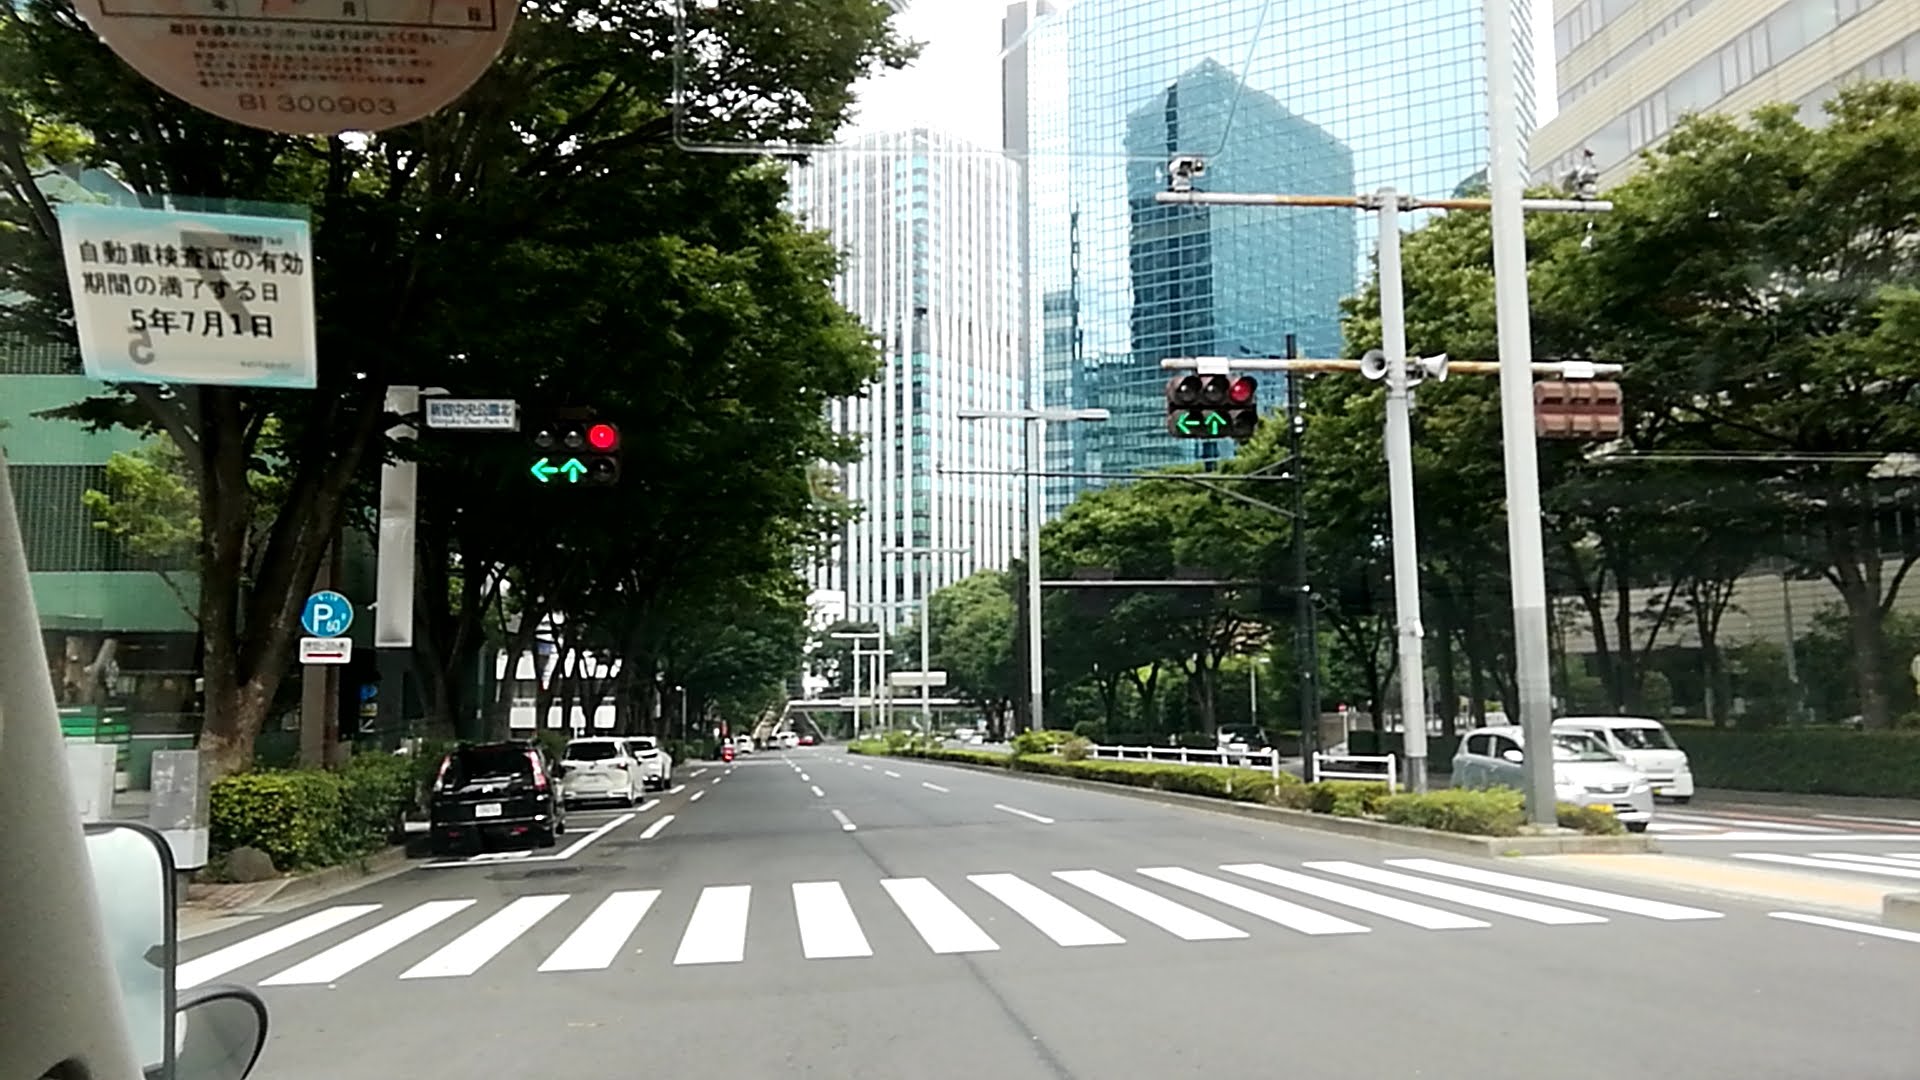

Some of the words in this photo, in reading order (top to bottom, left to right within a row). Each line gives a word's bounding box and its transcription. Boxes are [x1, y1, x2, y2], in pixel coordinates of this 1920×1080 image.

[343, 1, 357, 16] 月
[467, 7, 481, 22] 日
[278, 95, 396, 115] 300903
[79, 240, 304, 276] 自動車検査証の有効
[82, 271, 279, 303] 期間の満了する日
[130, 307, 274, 338] 5年7月1日
[313, 603, 334, 633] P
